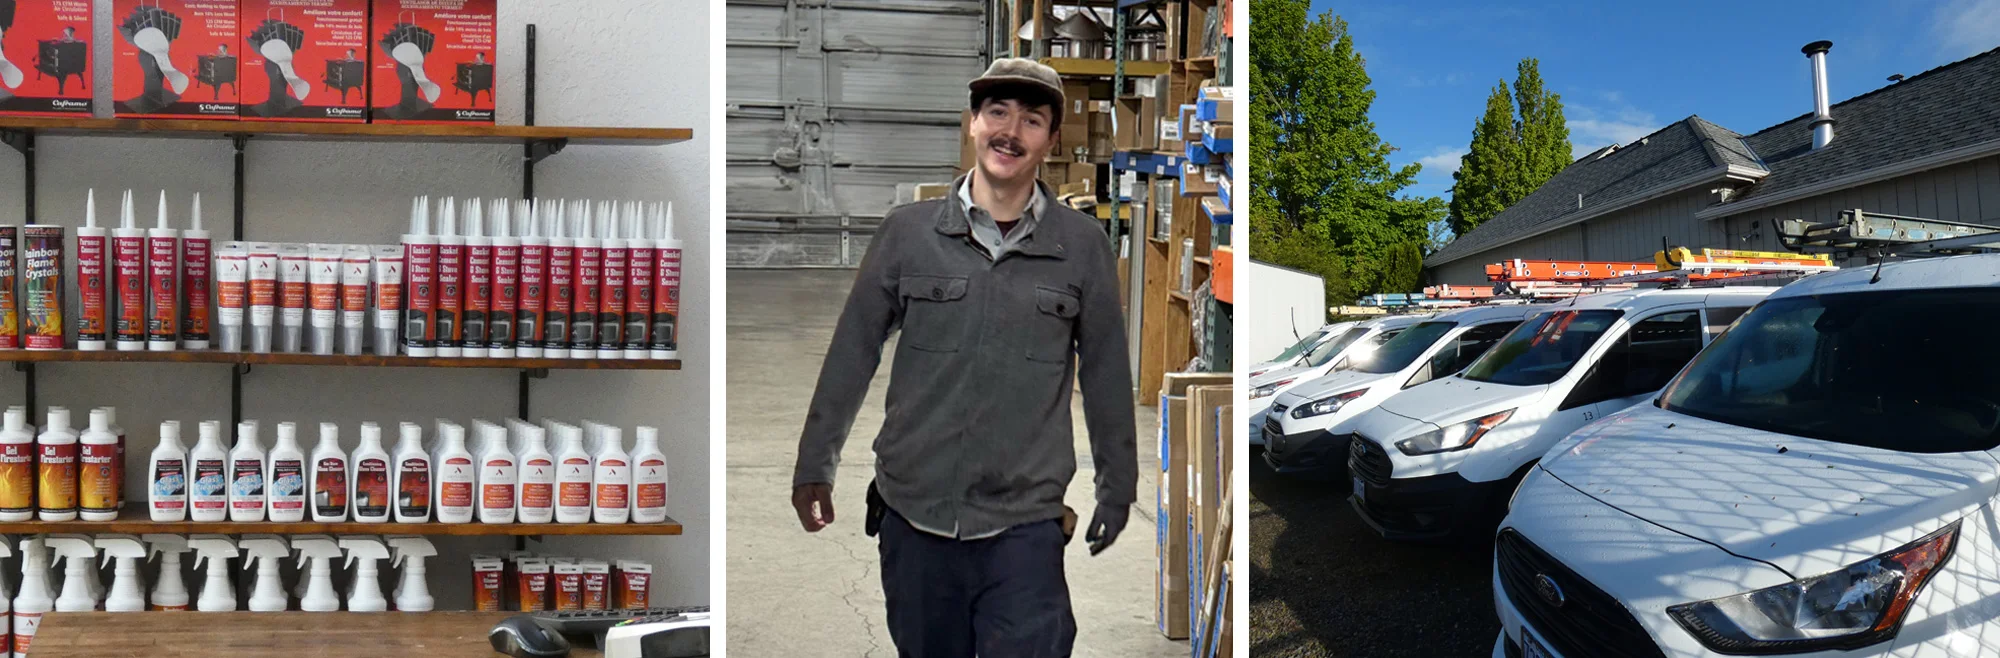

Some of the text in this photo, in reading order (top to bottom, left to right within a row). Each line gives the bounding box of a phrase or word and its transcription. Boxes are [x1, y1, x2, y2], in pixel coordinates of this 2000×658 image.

[25, 248, 59, 258] Rainbow
[27, 259, 54, 268] Flame
[25, 268, 59, 280] Crystals
[1583, 411, 1593, 420] 13
[6, 446, 18, 455] Gel
[45, 446, 56, 455] Gel
[82, 446, 91, 455] Gel
